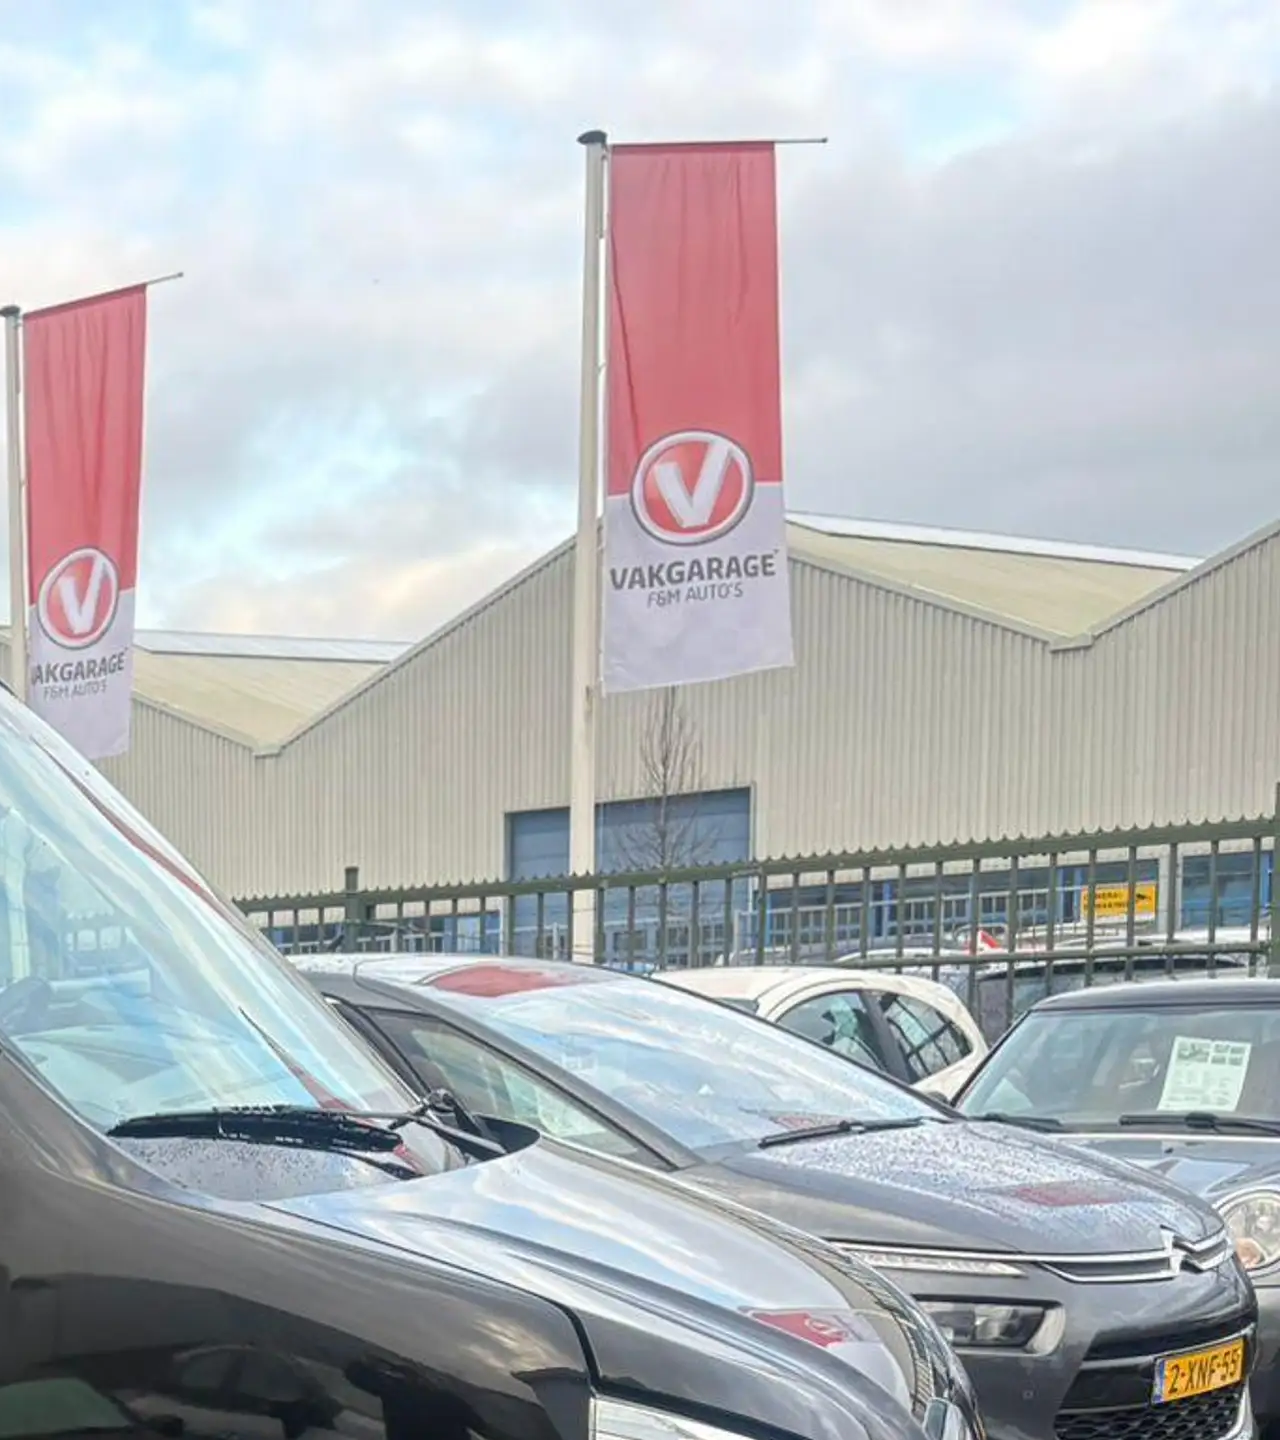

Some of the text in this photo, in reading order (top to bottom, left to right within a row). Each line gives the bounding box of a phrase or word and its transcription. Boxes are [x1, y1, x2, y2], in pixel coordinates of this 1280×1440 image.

[610, 553, 777, 591] VAKGARAGE
[646, 581, 744, 609] F&M AUTO'S
[30, 651, 126, 686] AKGARAGE
